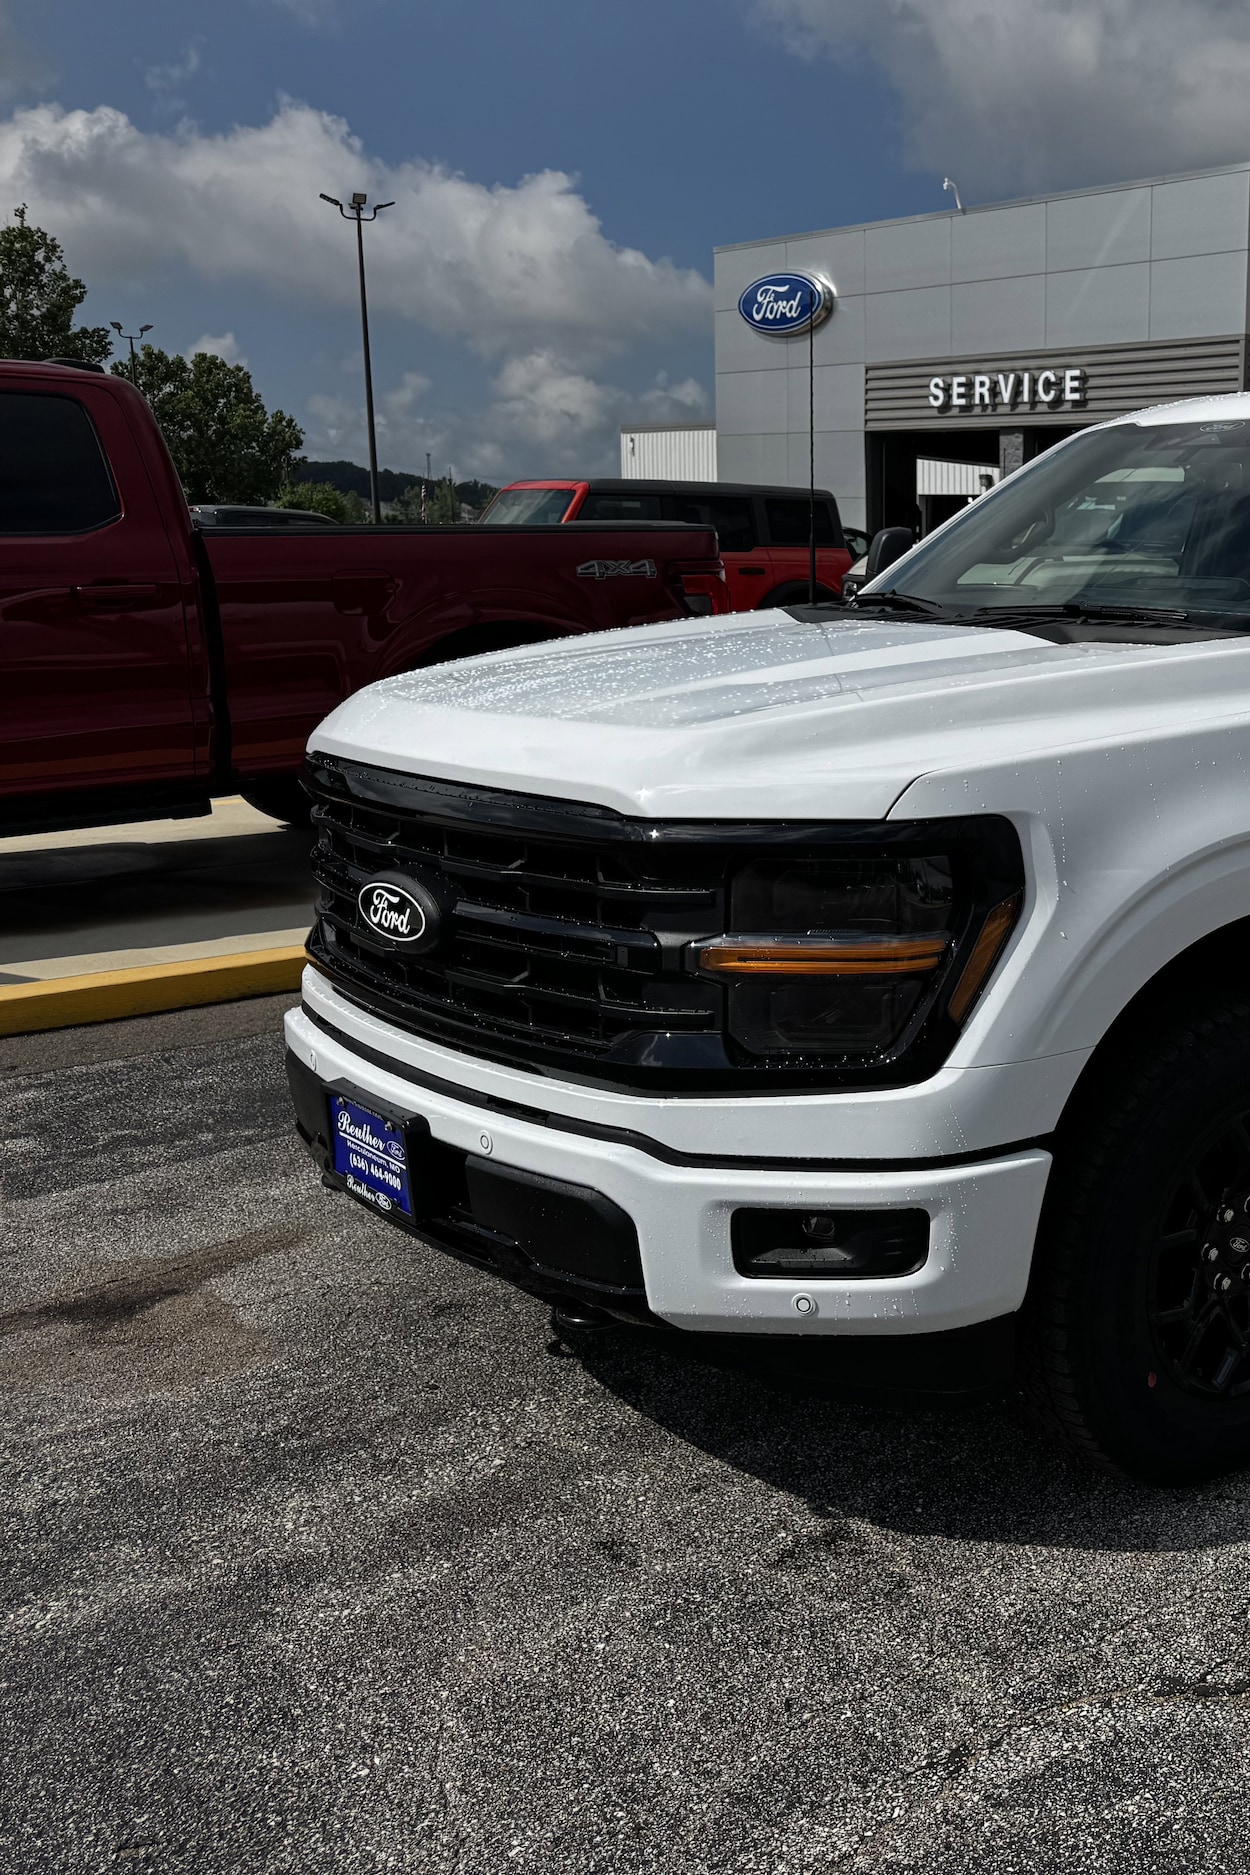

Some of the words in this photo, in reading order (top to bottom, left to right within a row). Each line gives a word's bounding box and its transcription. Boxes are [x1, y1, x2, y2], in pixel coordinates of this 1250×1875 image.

[753, 284, 802, 321] Ford
[929, 369, 1081, 407] SERVICE
[370, 888, 410, 934] Ford
[337, 1110, 386, 1151] Reuther
[349, 1152, 369, 1176] (636)
[370, 1163, 402, 1191] 464-9000
[388, 1161, 401, 1174] MO
